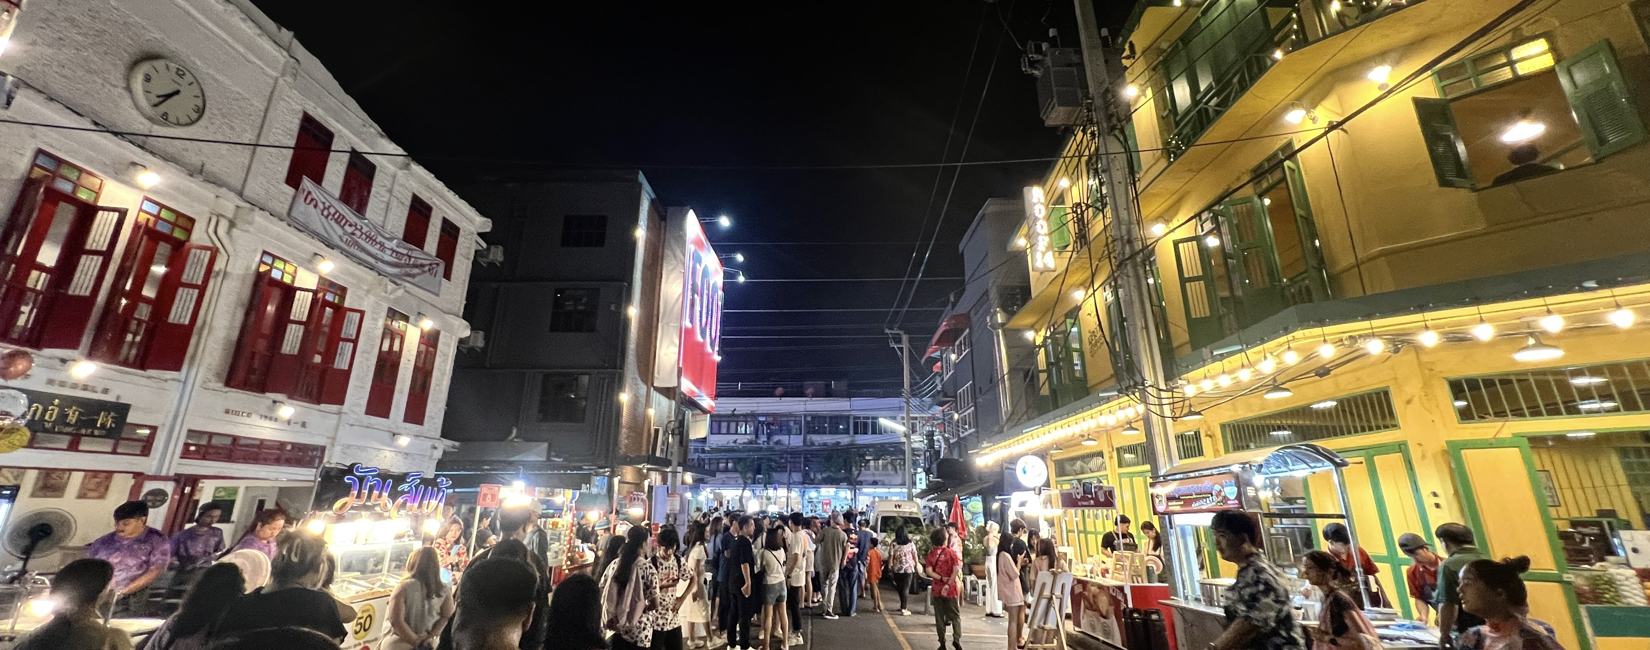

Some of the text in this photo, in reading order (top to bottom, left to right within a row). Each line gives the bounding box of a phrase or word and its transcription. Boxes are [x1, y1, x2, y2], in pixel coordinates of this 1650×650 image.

[144, 73, 152, 83] 9
[175, 67, 186, 79] 12
[191, 104, 200, 113] 3
[161, 111, 169, 121] 6
[685, 243, 724, 362] FOO
[224, 408, 253, 418] SINCE
[354, 613, 373, 635] 50
